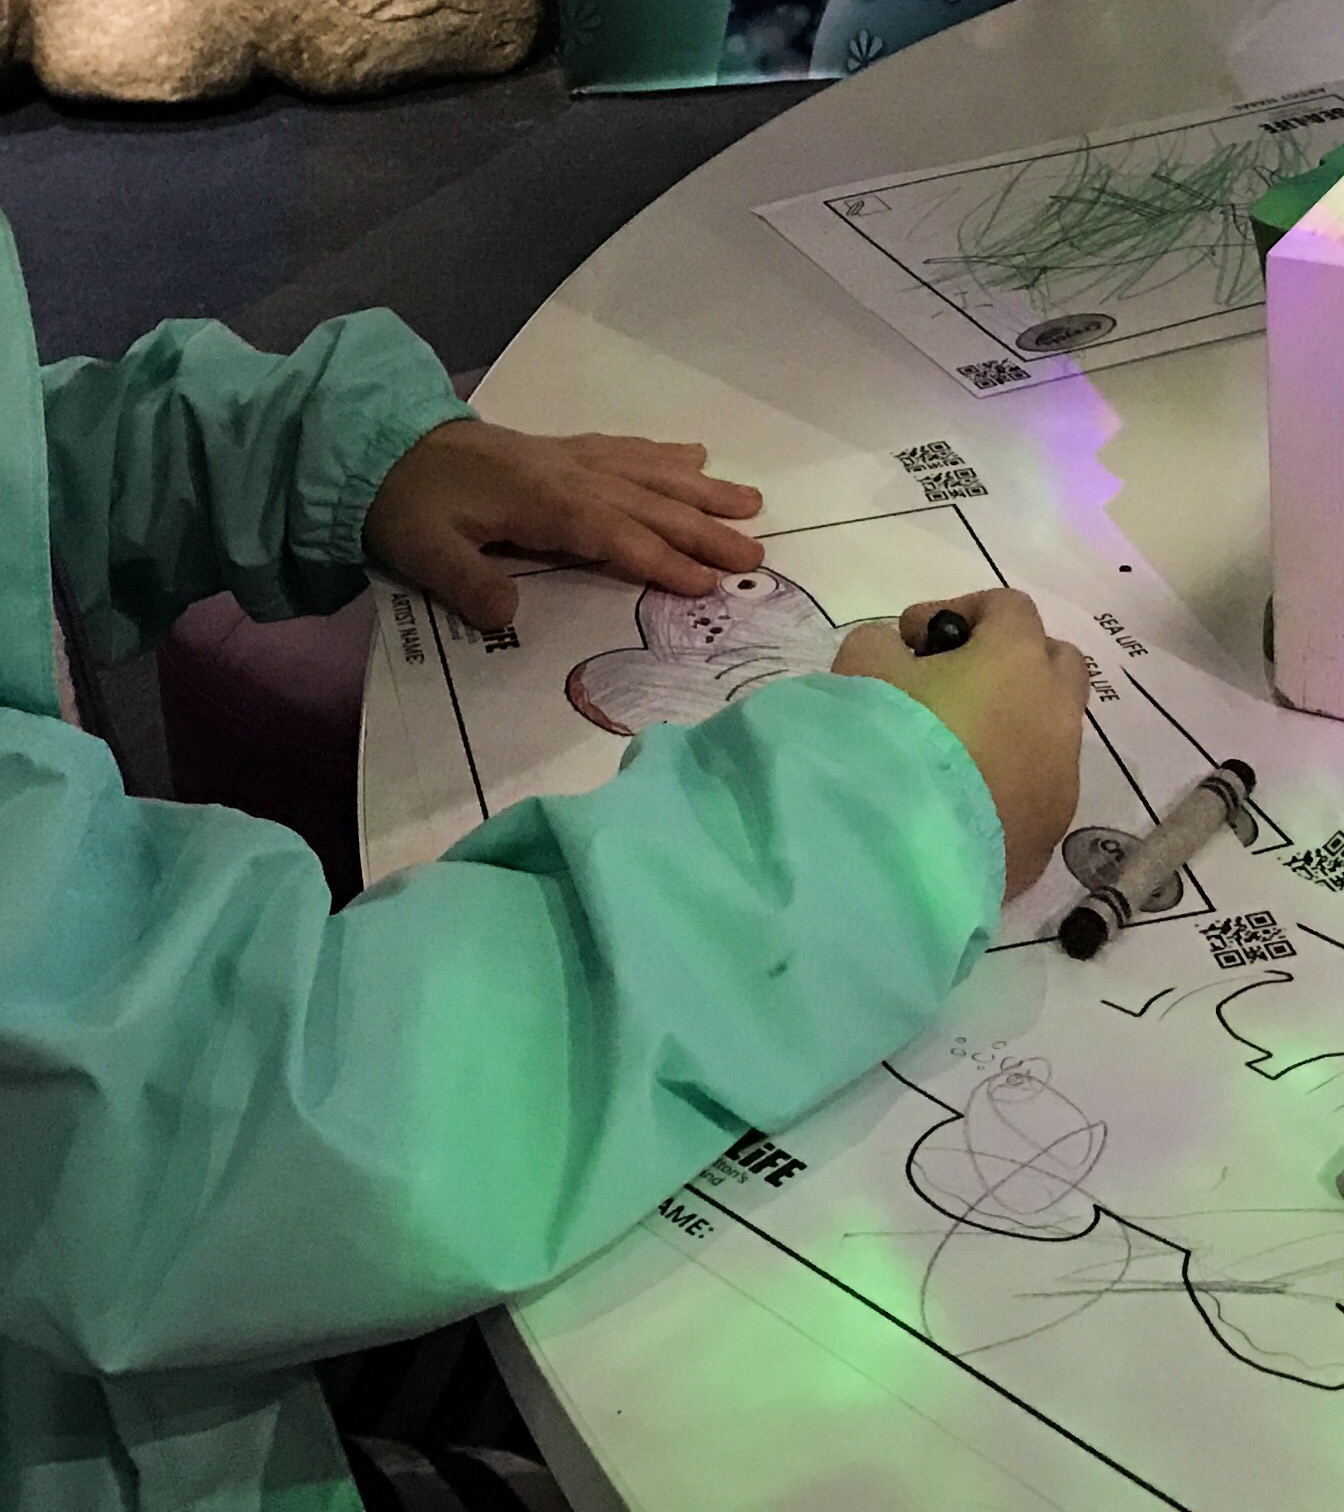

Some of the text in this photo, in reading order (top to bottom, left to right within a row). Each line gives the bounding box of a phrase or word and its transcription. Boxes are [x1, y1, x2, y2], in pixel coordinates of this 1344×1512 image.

[391, 593, 416, 630] ARTIST
[1093, 613, 1148, 658] SEA LIFE
[1090, 680, 1120, 702] LIFE
[657, 1197, 714, 1240] AME:
